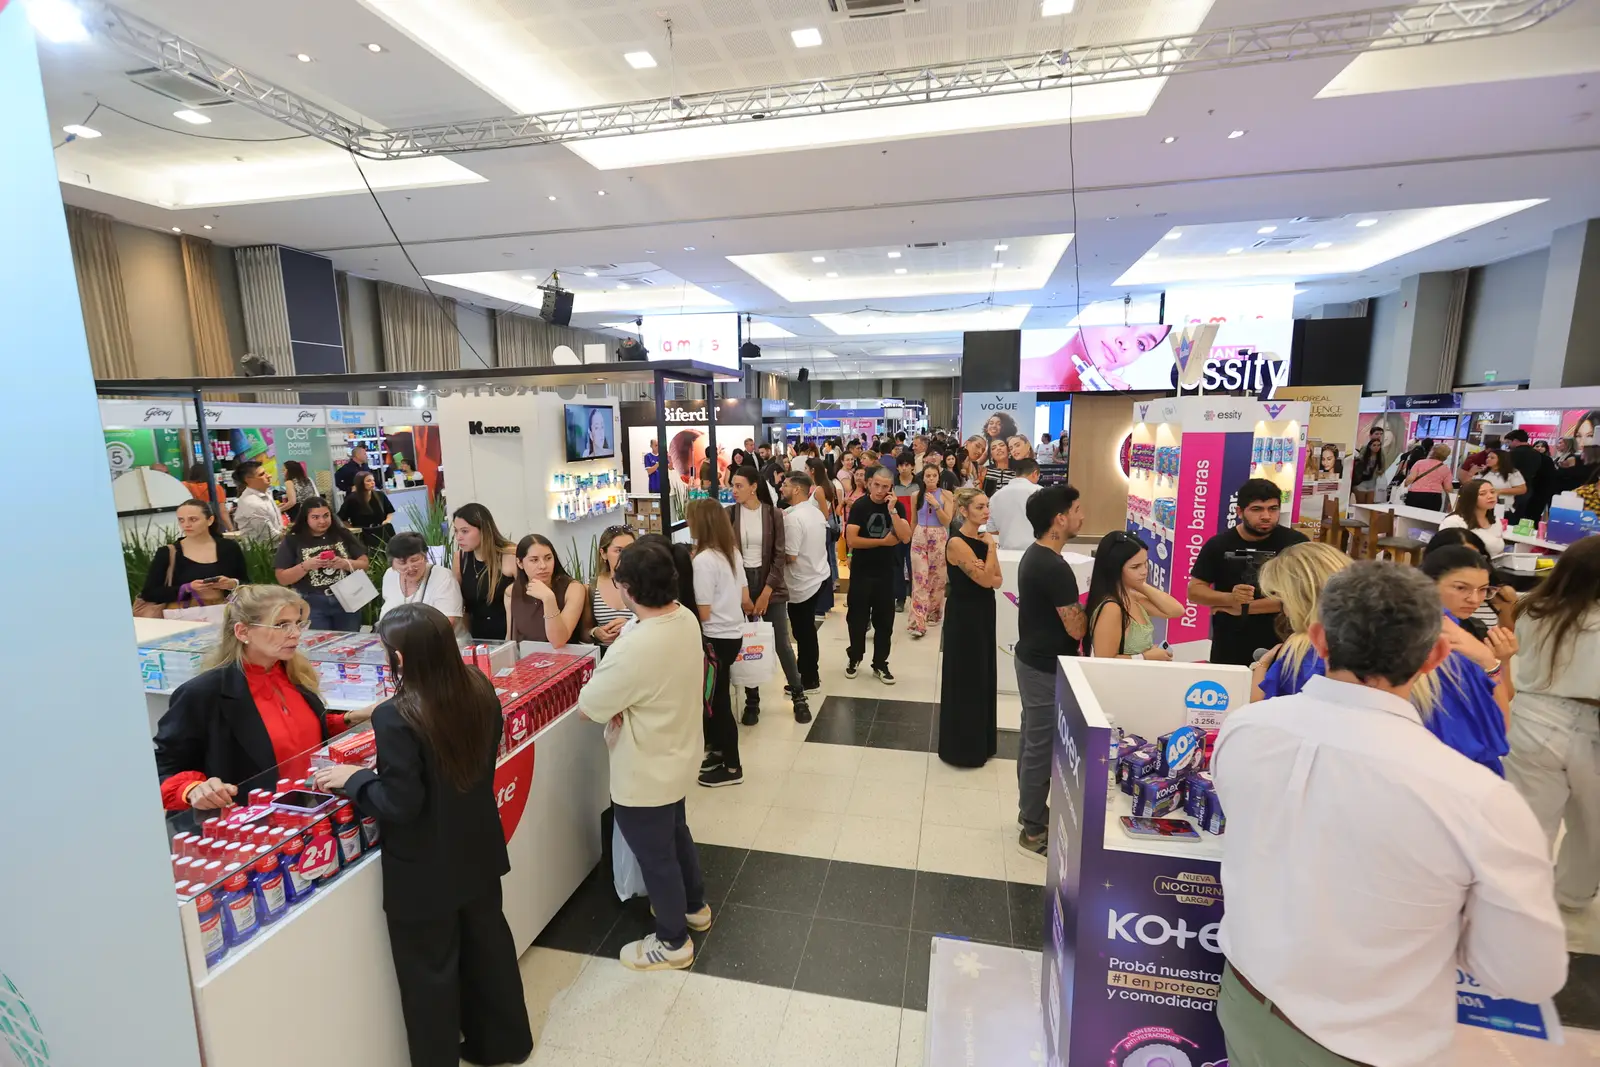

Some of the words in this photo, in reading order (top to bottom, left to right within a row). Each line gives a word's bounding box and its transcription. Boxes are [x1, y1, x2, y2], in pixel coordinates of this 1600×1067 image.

[980, 403, 1018, 411] VOGUE
[1217, 409, 1243, 421] essity
[288, 442, 312, 450] power
[1187, 459, 1210, 530] barreras
[511, 713, 526, 733] 2x1
[343, 742, 373, 757] Colgate
[302, 840, 334, 869] 2x1
[1182, 872, 1211, 882] NUEVA
[1180, 895, 1209, 905] LARGA
[1109, 957, 1156, 975] Probá
[1111, 972, 1128, 985] #1
[1132, 976, 1151, 989] en
[1153, 980, 1223, 999] protecci
[1106, 987, 1116, 1000] y
[1129, 1028, 1144, 1038] CON
[1143, 1026, 1171, 1036] ESCUDO
